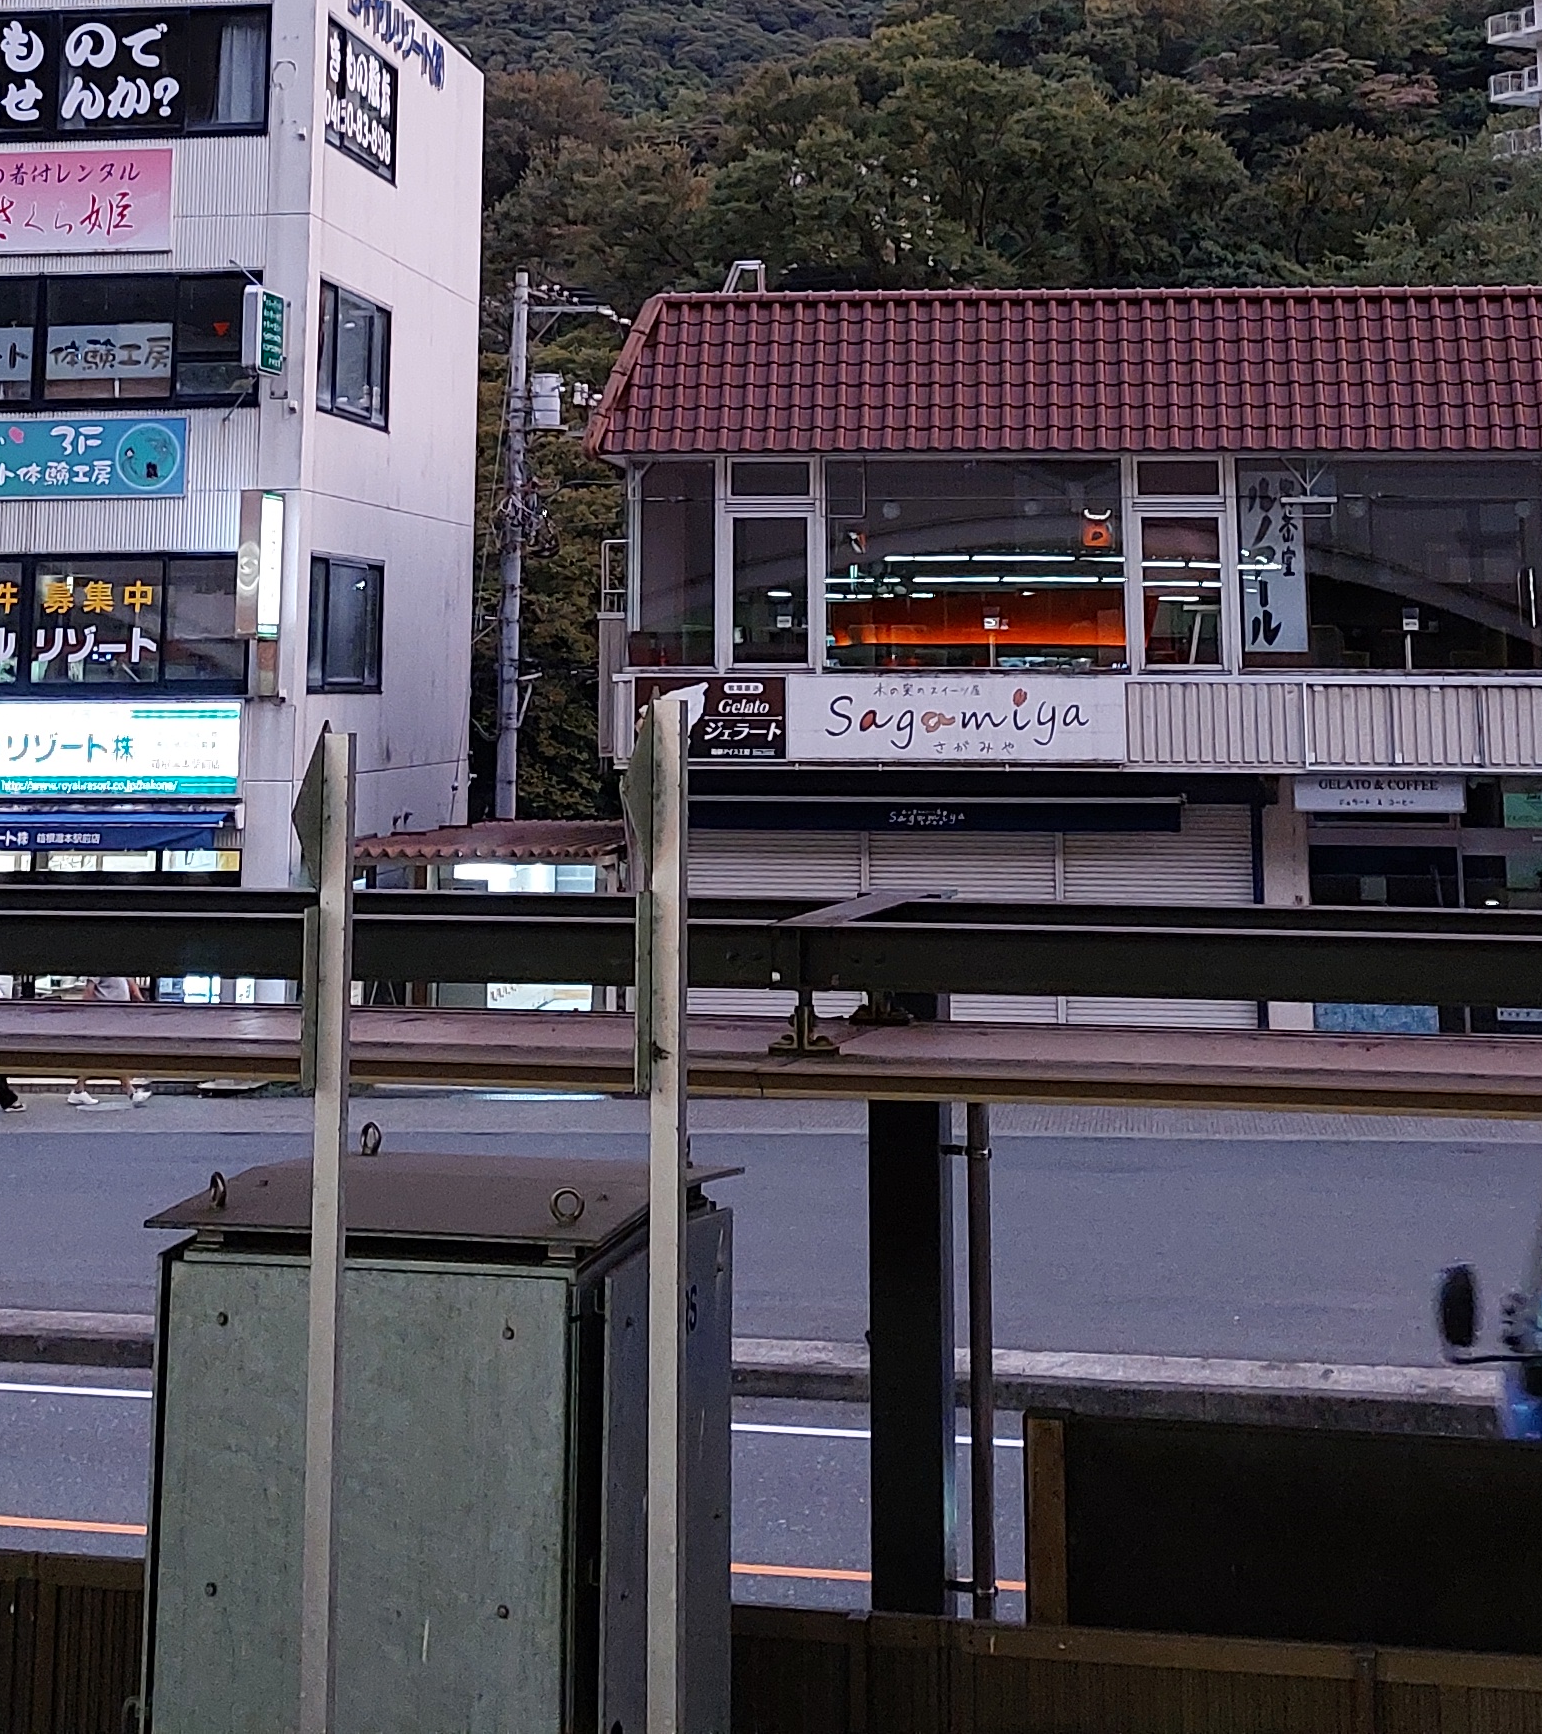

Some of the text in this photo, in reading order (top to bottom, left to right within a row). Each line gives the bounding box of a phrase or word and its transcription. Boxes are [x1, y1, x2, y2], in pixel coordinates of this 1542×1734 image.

[50, 426, 104, 456] 3F
[718, 698, 770, 714] Gelato
[824, 687, 1090, 750] Sagamiya
[704, 721, 782, 741] ジェラート
[932, 741, 1015, 754] さがみや
[1318, 778, 1439, 791] GELATO & COFFEE
